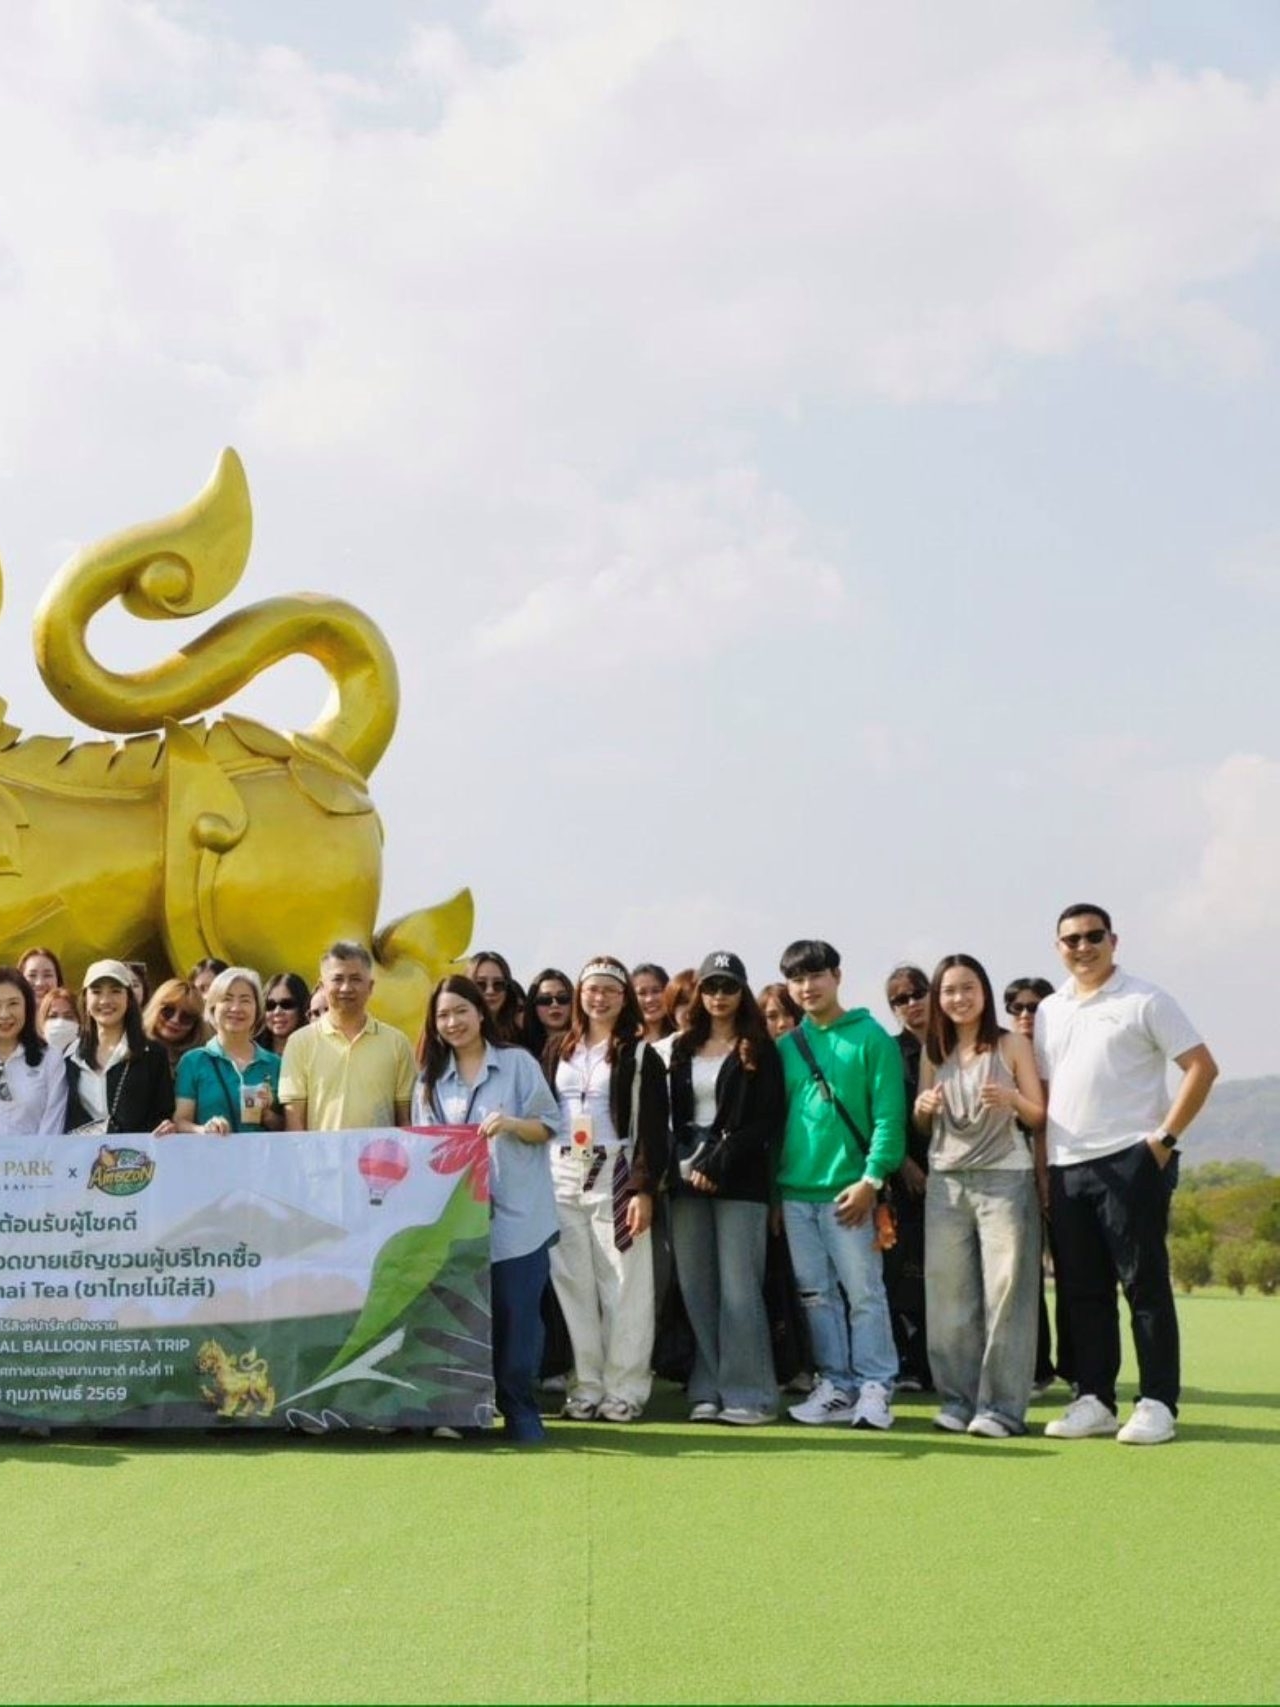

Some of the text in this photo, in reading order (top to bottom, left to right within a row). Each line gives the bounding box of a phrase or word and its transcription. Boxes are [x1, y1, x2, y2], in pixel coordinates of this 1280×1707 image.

[4, 1160, 54, 1177] PARK
[31, 1282, 69, 1299] Tea
[74, 1277, 216, 1300] (ชาไทยไม่ใส่สี)
[23, 1339, 96, 1353] BALLOON
[100, 1339, 152, 1352] FIESTA
[155, 1338, 191, 1352] TRIP
[164, 1364, 175, 1376] 11
[5, 1384, 83, 1405] กุมภาพันธ์
[86, 1386, 128, 1401] 2569
